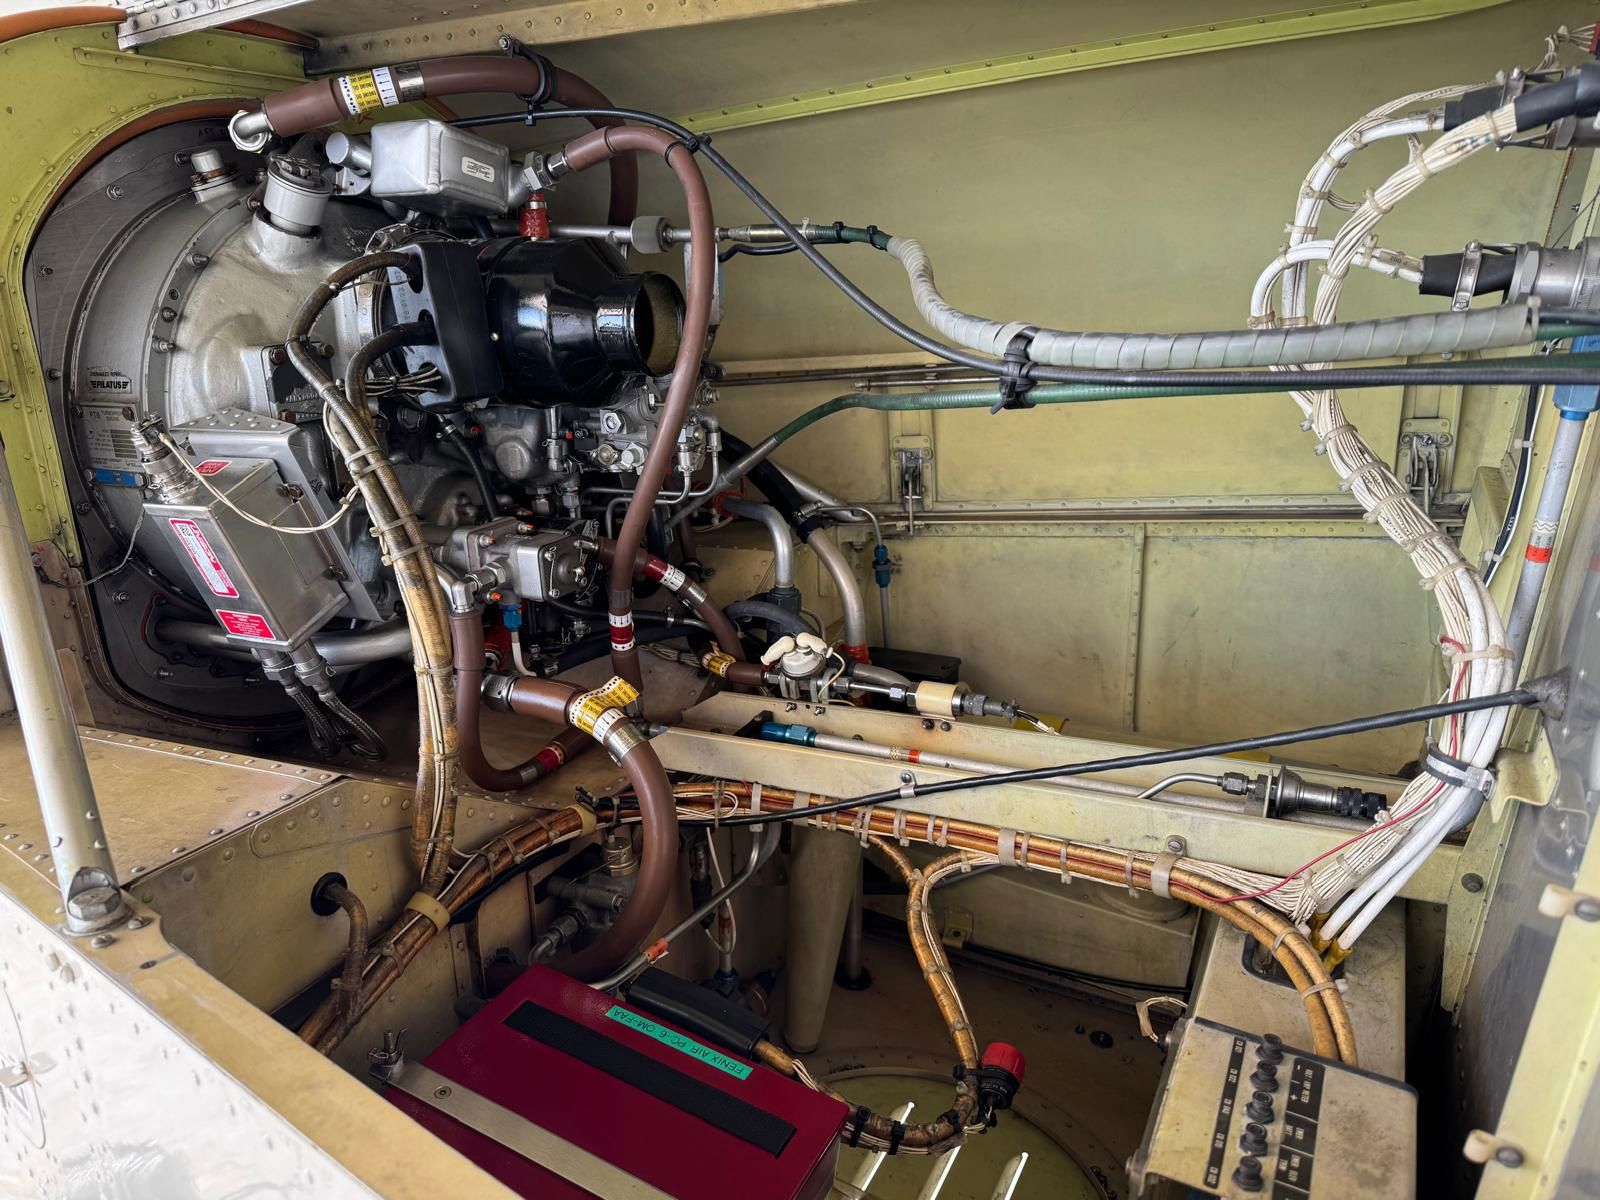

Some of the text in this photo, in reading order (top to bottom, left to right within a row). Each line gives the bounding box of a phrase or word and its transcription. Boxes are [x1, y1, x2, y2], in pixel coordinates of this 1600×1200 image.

[97, 380, 122, 389] PILATUS
[614, 1009, 744, 1075] FENIX AIR PC-6 OM-FAA
